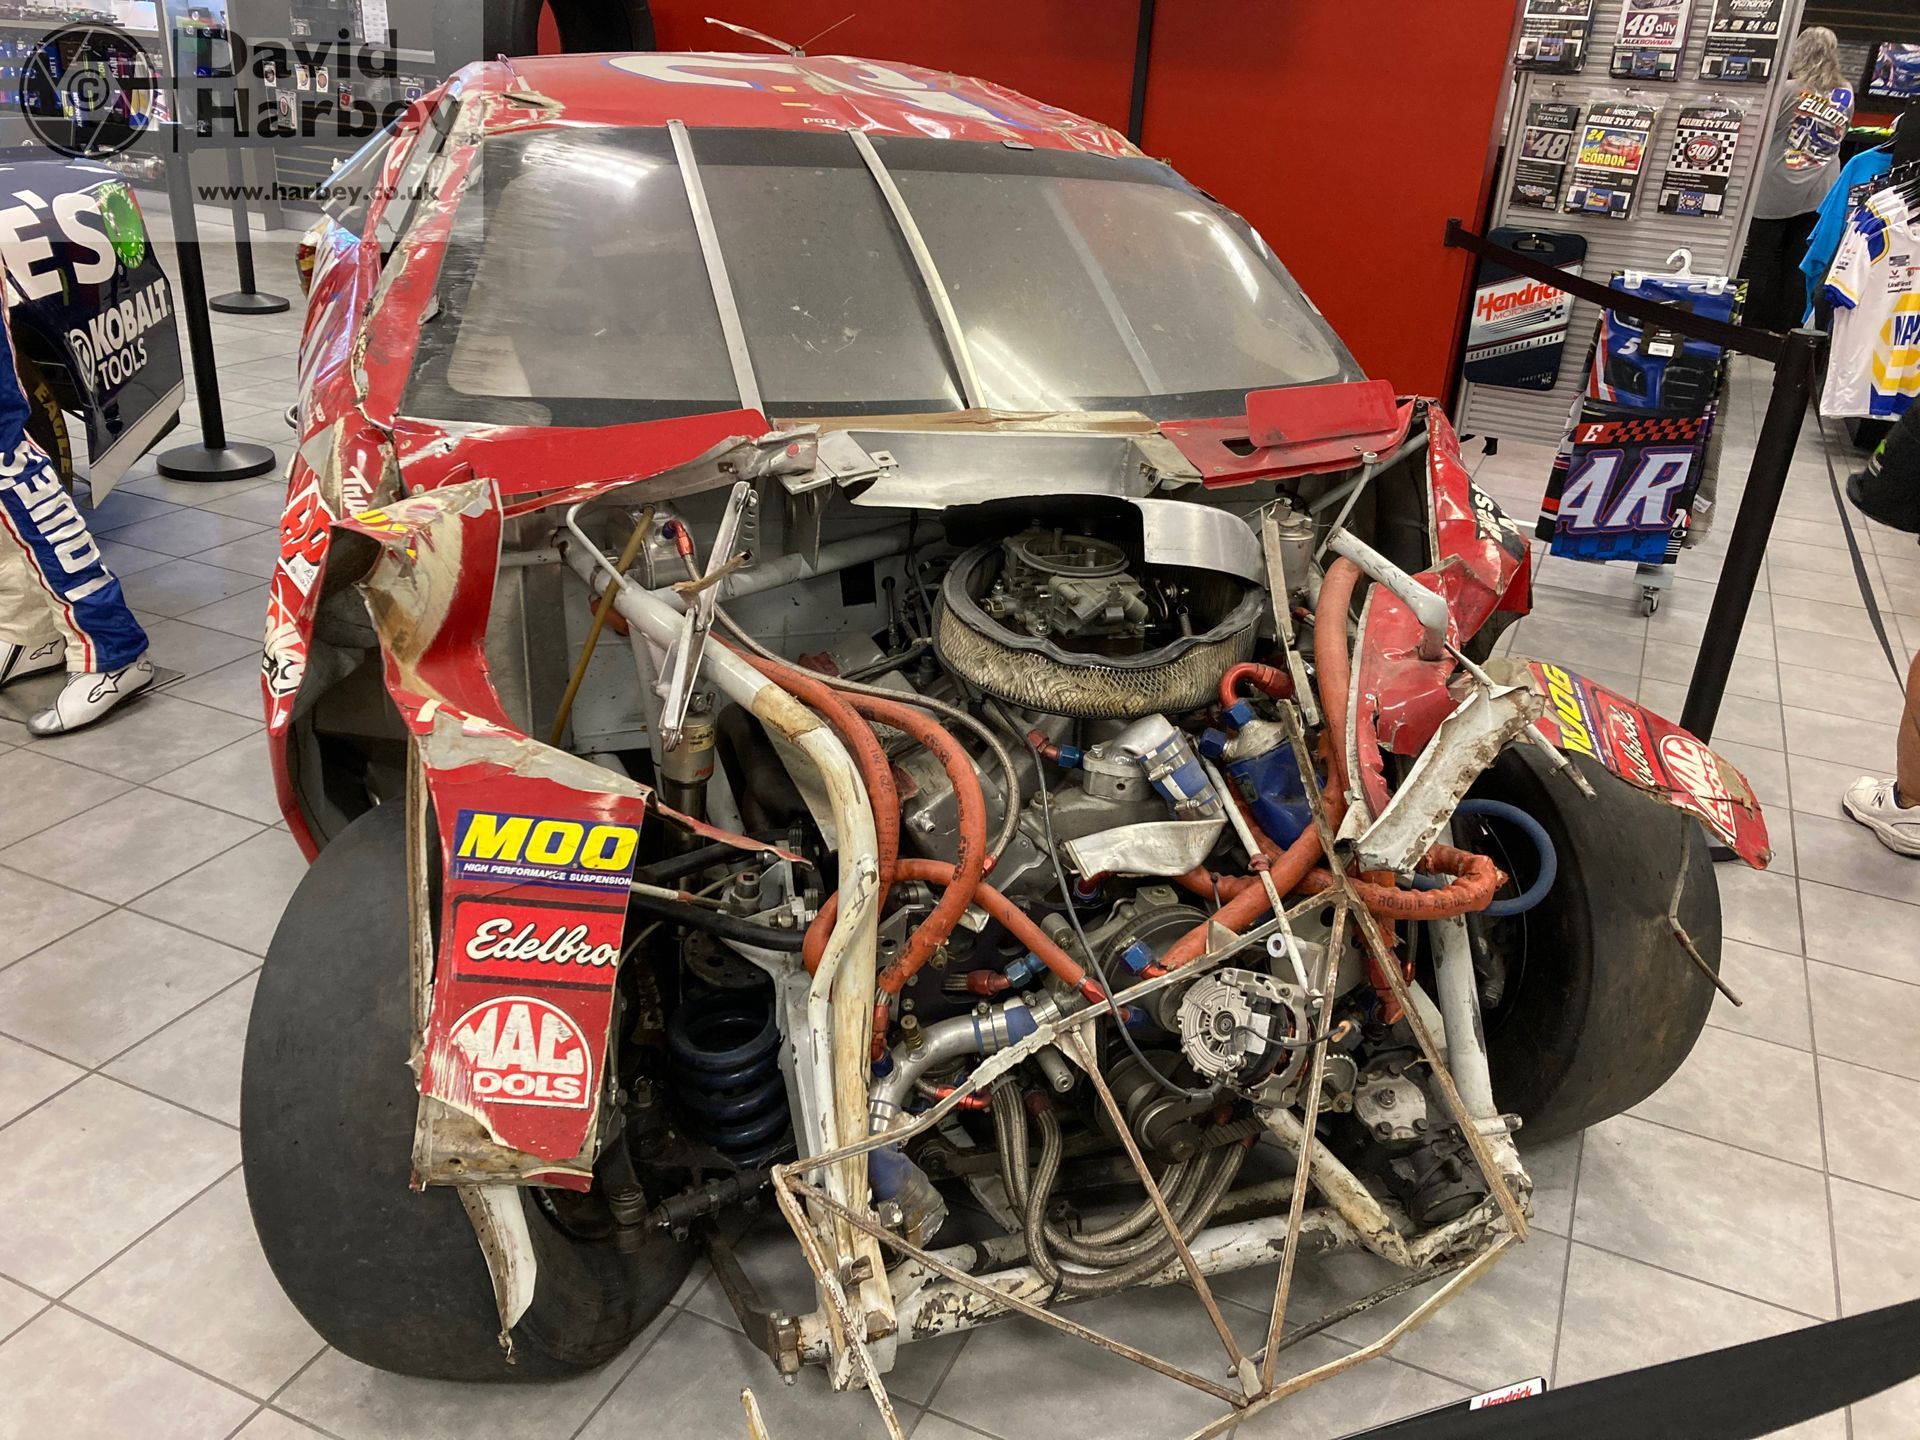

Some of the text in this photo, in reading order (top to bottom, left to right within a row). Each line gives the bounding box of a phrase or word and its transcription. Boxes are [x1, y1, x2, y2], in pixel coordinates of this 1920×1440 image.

[1625, 14, 1677, 36] 48 ally
[1746, 20, 1761, 32] 24
[1762, 21, 1777, 33] 48
[1829, 87, 1852, 113] 9
[1554, 116, 1569, 124] FLAG
[1587, 114, 1613, 124] DELUXE
[1632, 119, 1652, 129] FLAG
[1612, 108, 1639, 117] NASCAR
[1679, 117, 1704, 127] DELUXE
[1721, 121, 1741, 130] FLAG
[1797, 97, 1849, 128] ELLIOTT
[1531, 133, 1571, 159] 48
[1586, 128, 1606, 141] 24
[1583, 152, 1627, 167] GORDON
[1687, 144, 1718, 159] 300
[1887, 280, 1913, 289] UniFirst
[1476, 282, 1565, 322] Hendric
[1493, 296, 1565, 321] MOTORSPORTS
[88, 277, 171, 361] KOBALT
[1470, 333, 1560, 360] ESTABLISHED 1984
[1616, 336, 1642, 355] 5
[98, 336, 148, 391] TOOLS
[34, 382, 71, 475] EAGLE
[1556, 449, 1695, 531] AR
[457, 813, 639, 871] MOO
[463, 862, 632, 886] HIGH PERFORMANCE SUSPENSION
[451, 1003, 584, 1076] MAC
